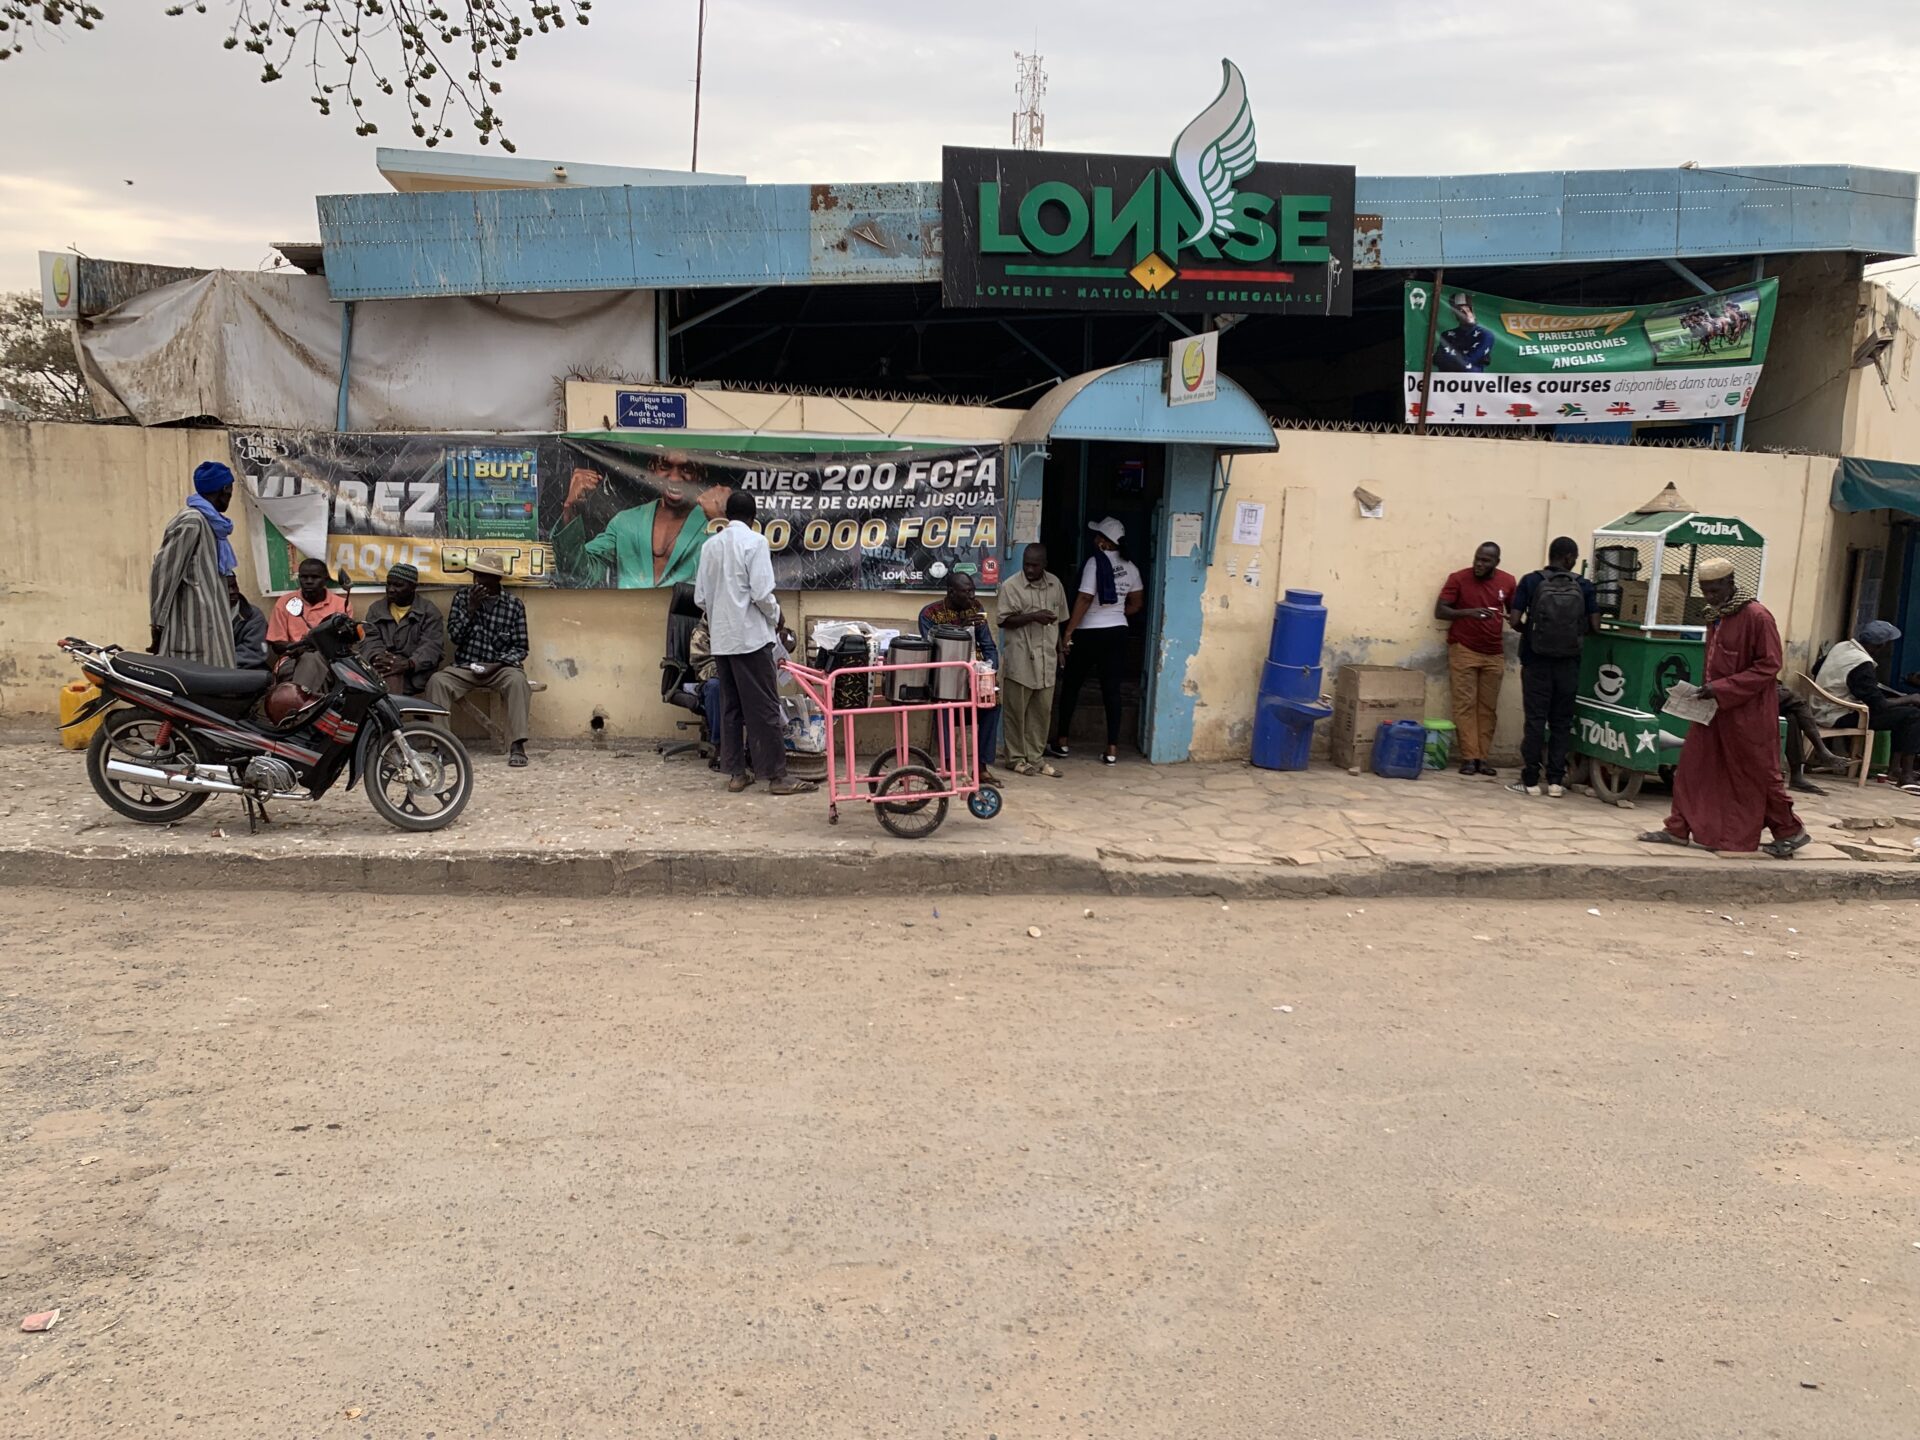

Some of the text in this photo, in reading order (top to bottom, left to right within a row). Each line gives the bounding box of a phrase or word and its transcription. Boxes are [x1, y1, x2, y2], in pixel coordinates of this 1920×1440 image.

[979, 168, 1332, 264] LONASE
[976, 284, 1323, 303] LOTERIE NATIONALE SENEGALAISE
[1538, 329, 1597, 341] PARIEZ SUR
[1519, 337, 1628, 356] LES HIPPODROMES
[1552, 353, 1606, 369] ANGLAIS
[1408, 375, 1424, 393] De
[1433, 375, 1531, 393] nouvelles
[1537, 379, 1611, 393] courses
[1614, 376, 1677, 395] disponibles
[1679, 376, 1705, 389] dans
[1707, 377, 1727, 389] tous
[1730, 373, 1741, 387] les
[629, 395, 673, 405] Rufisque Est
[644, 403, 659, 411] Rue
[628, 410, 651, 418] André
[638, 417, 666, 426] (RE-37)
[474, 462, 529, 479] BUT!
[741, 458, 996, 491] AVEC 200 FCFA
[755, 495, 814, 510] ENTEZ
[818, 496, 841, 509] DE
[846, 494, 916, 510] GAGNER
[804, 518, 888, 551] 000
[896, 516, 997, 549] FCFA
[1689, 520, 1744, 541] TOUBA
[326, 542, 433, 577] AQUE
[1579, 717, 1631, 759] TOUBA
